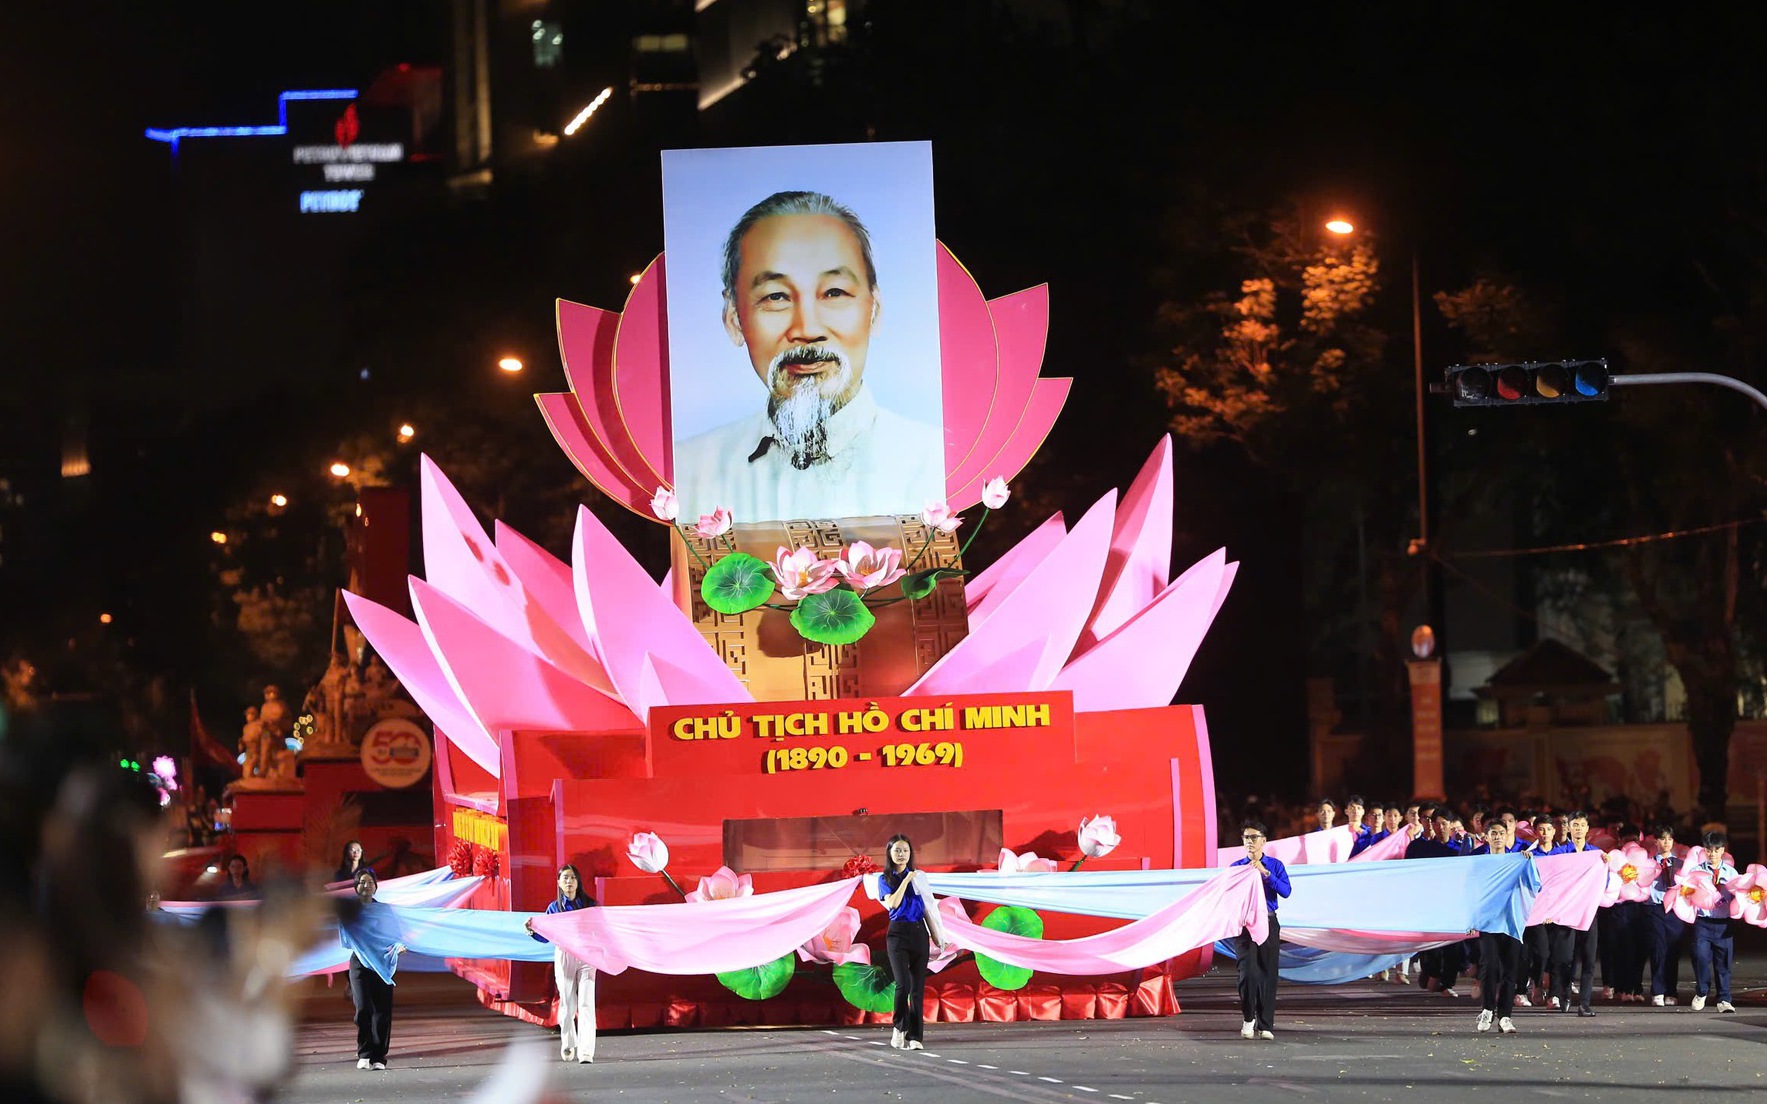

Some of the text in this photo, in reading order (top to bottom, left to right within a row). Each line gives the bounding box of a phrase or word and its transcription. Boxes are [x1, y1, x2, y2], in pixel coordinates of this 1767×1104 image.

[323, 163, 375, 182] TOWER
[673, 702, 1050, 742] CHỦ TỊCH HỒ CHÍ MINH
[767, 745, 848, 774] (1890
[882, 742, 963, 768] 1969)
